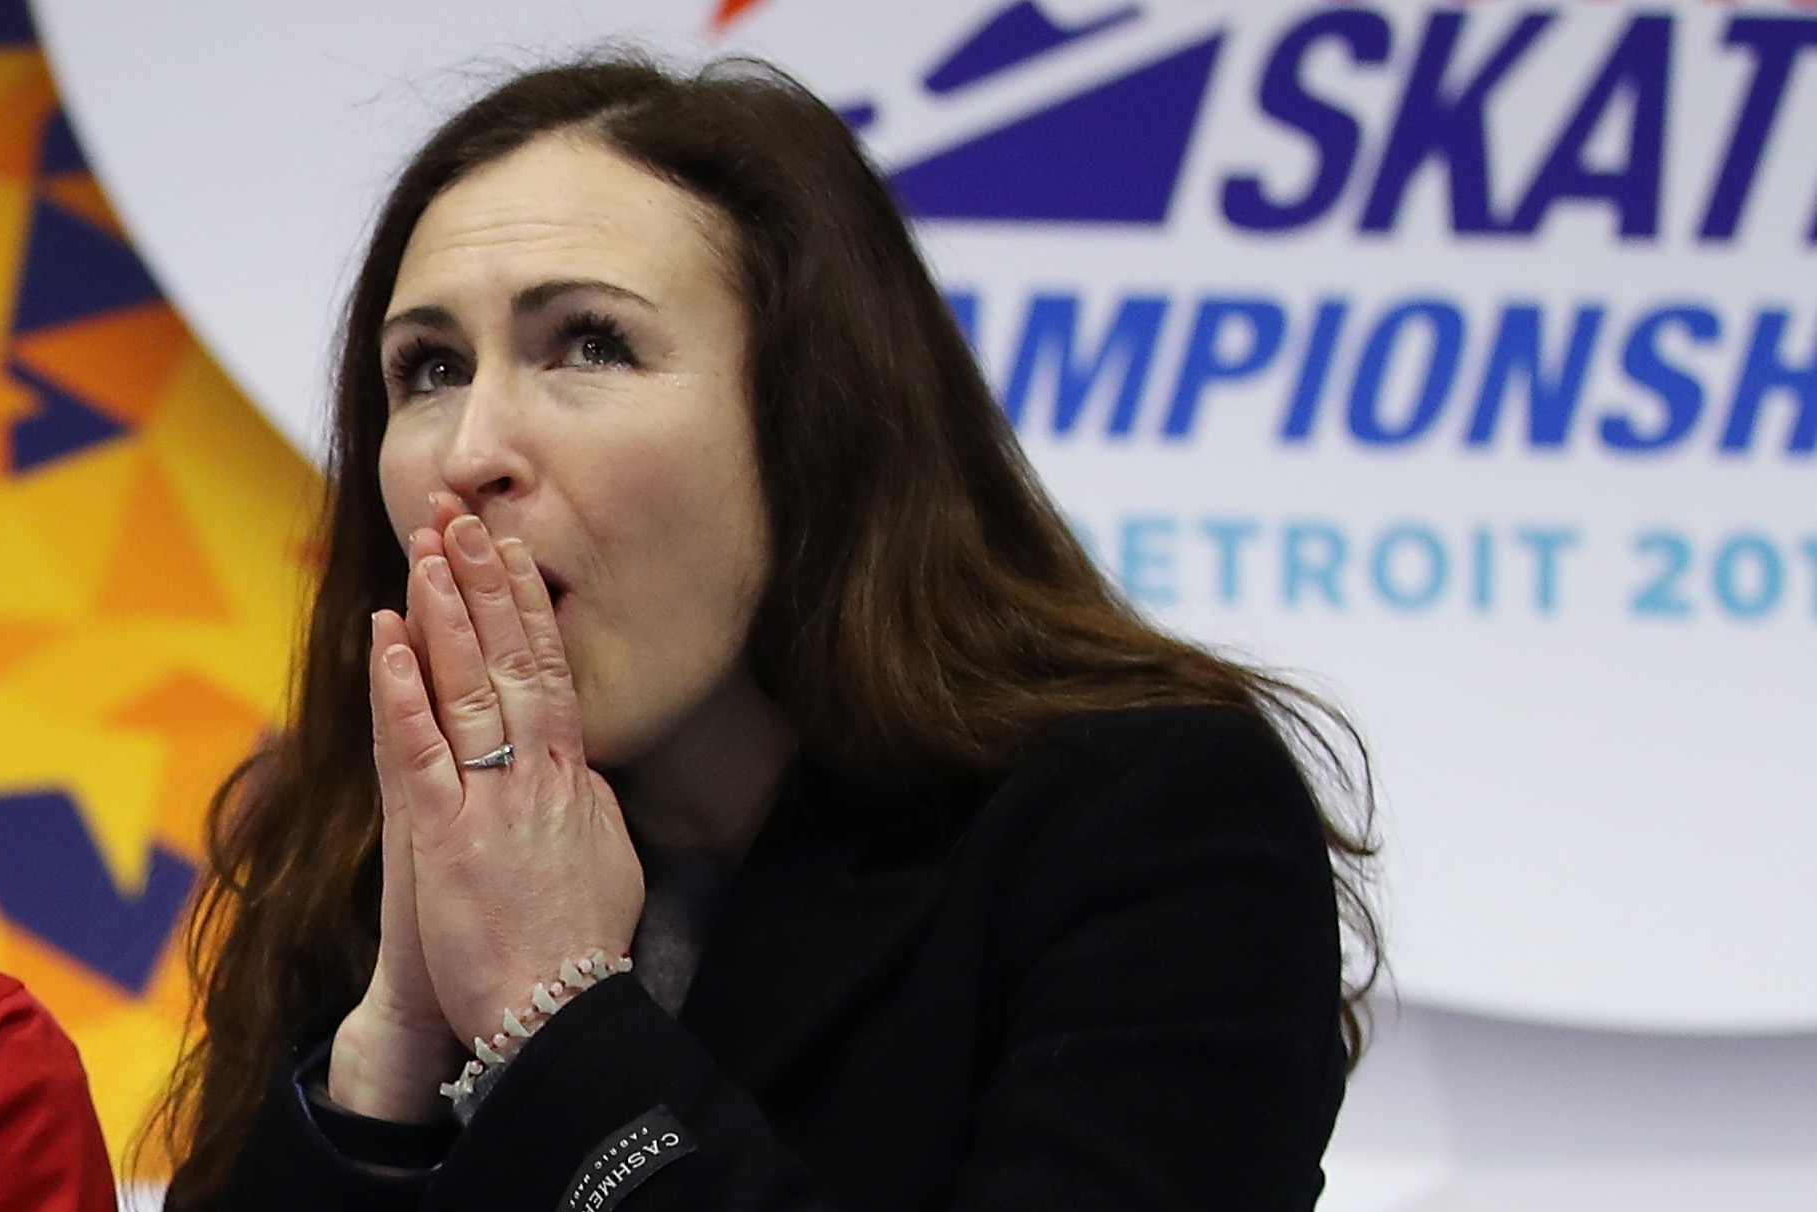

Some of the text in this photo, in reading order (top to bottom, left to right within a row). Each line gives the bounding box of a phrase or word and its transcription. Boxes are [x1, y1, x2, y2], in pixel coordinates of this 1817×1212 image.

[1218, 5, 1817, 243] SKAT
[945, 290, 1817, 457] MPIONSH
[1073, 518, 1583, 614] ETROIT
